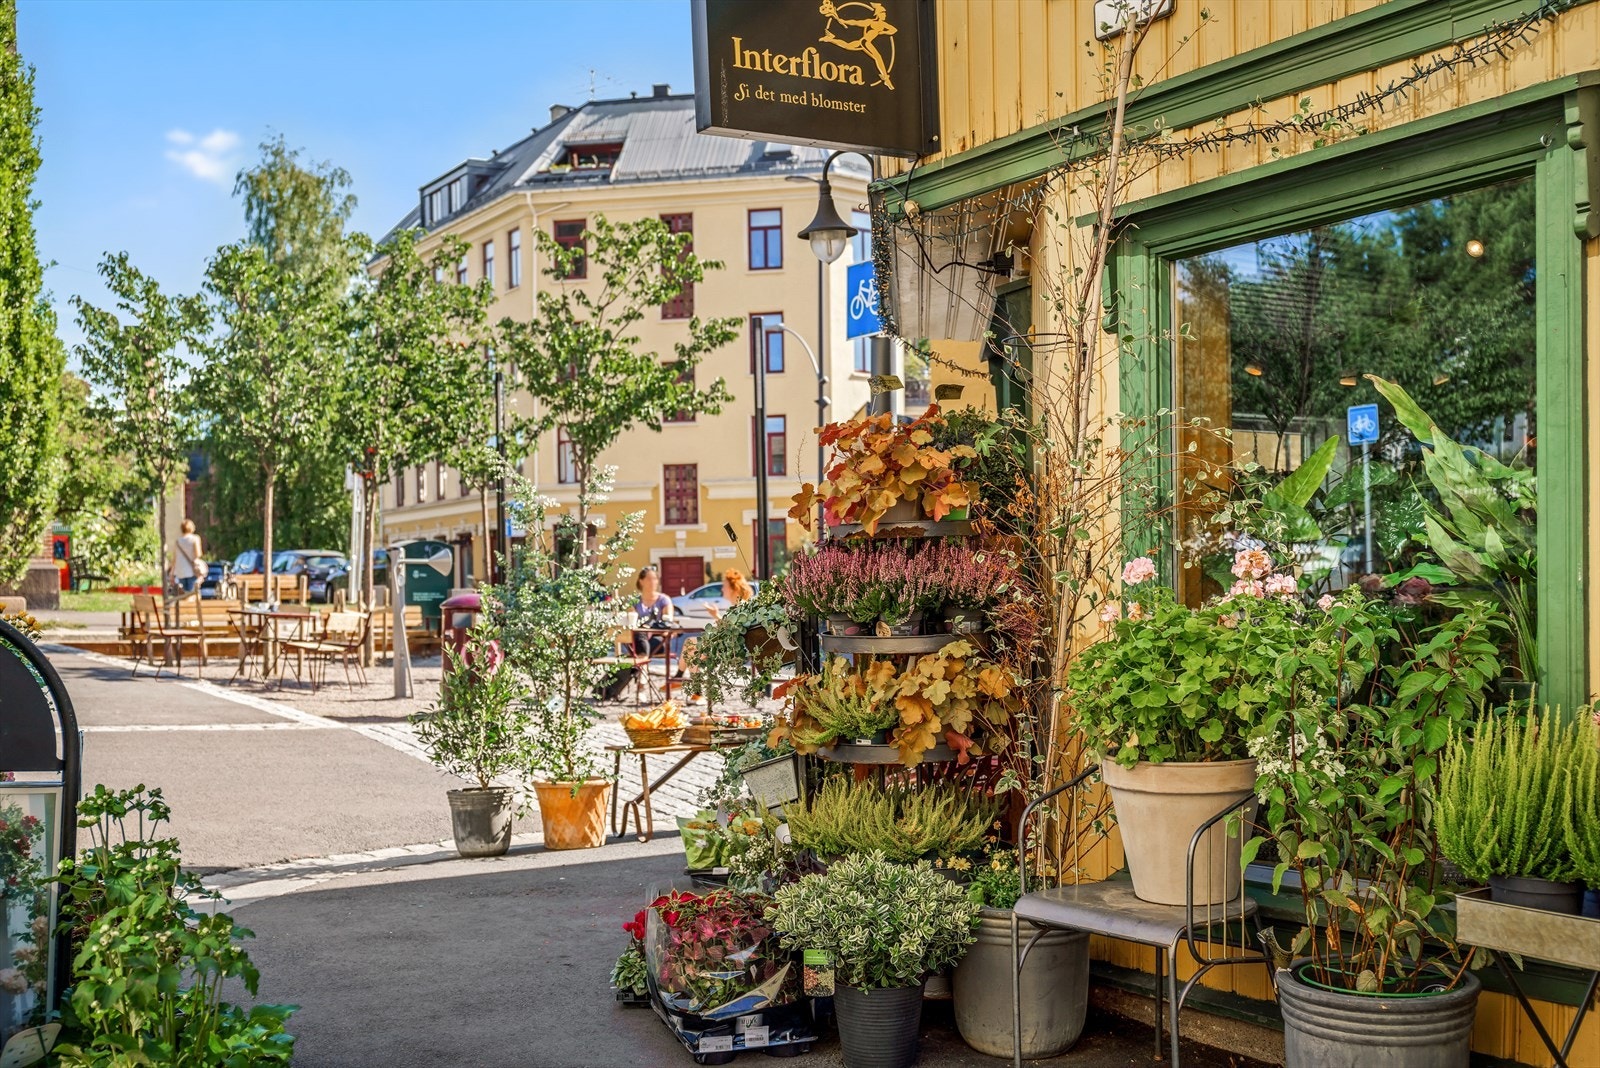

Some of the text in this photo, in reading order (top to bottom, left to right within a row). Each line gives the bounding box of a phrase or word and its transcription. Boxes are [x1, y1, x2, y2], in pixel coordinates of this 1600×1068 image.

[731, 36, 865, 86] Interflora
[734, 83, 866, 113] Si det med blomster
